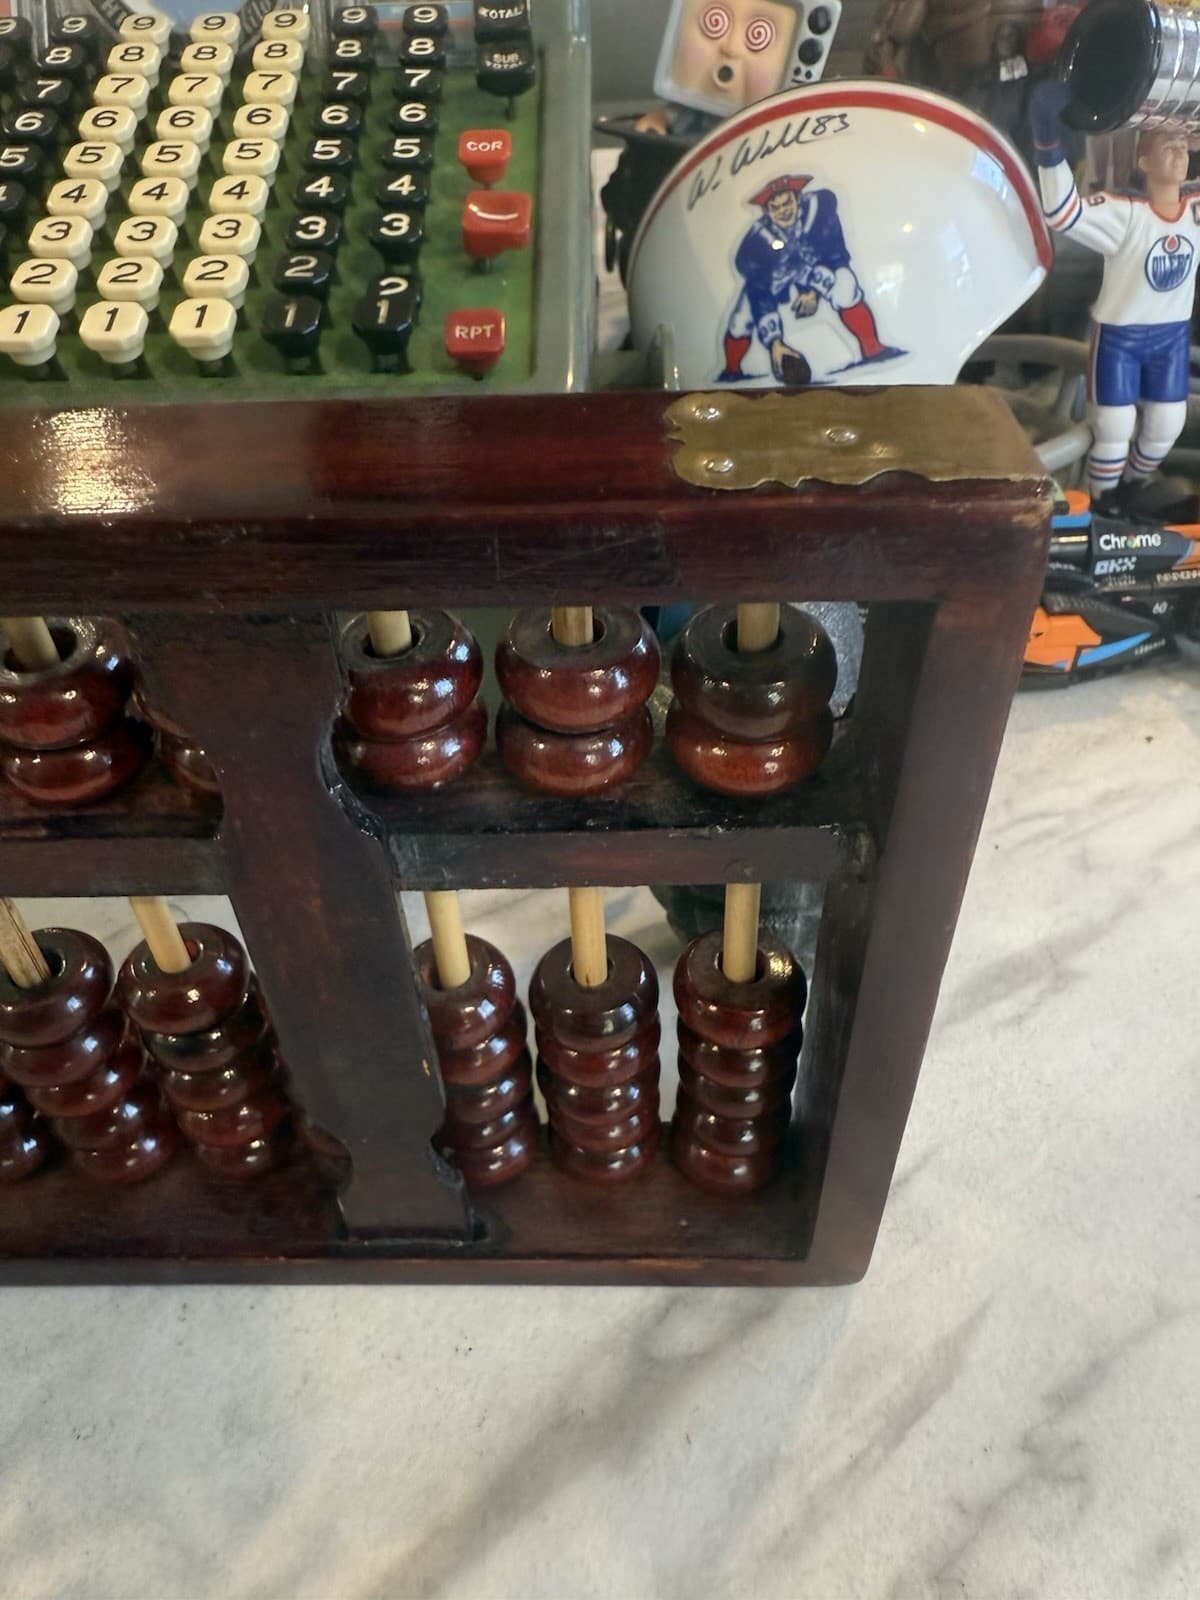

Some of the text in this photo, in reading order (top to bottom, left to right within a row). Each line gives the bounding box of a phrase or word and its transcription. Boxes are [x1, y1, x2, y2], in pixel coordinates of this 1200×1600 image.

[132, 16, 156, 30] 9
[203, 16, 226, 30] 9
[274, 13, 297, 28] 9
[342, 7, 367, 23] 9
[413, 7, 438, 23] 9
[61, 17, 87, 33] 9
[46, 47, 72, 63] 8
[119, 46, 144, 62] 8
[192, 46, 217, 60] 8
[263, 43, 288, 58] 8
[336, 40, 362, 57] 8
[408, 38, 435, 55] 8
[110, 77, 134, 93] 7
[184, 77, 208, 92] 7
[258, 74, 282, 90] 7
[332, 73, 358, 90] 7
[405, 69, 431, 87] 7
[37, 80, 62, 98] 7
[15, 112, 45, 131] 6
[91, 110, 117, 128] 6
[169, 110, 194, 127] 6
[247, 108, 272, 124] 6
[321, 105, 350, 124] 6
[400, 103, 427, 122] 6
[76, 146, 106, 163] 5
[154, 145, 184, 162] 5
[235, 142, 263, 159] 5
[312, 140, 342, 160] 5
[392, 138, 421, 158] 5
[466, 140, 503, 151] COR
[0, 147, 29, 167] 5
[61, 184, 87, 203] 4
[142, 182, 169, 200] 4
[223, 181, 250, 199] 4
[305, 176, 334, 197] 4
[388, 174, 416, 195] 4
[42, 221, 72, 241] 3
[127, 221, 158, 241] 3
[213, 219, 242, 238] 3
[296, 216, 327, 239] 3
[380, 213, 411, 236] 3
[22, 264, 57, 284] 2
[109, 262, 142, 284] 2
[195, 260, 229, 280] 2
[284, 256, 318, 277] 2
[104, 307, 120, 332] 1
[195, 304, 208, 328] 1
[285, 303, 298, 328] 1
[377, 299, 389, 324] 1
[14, 310, 30, 333] 1
[455, 324, 495, 340] RPT
